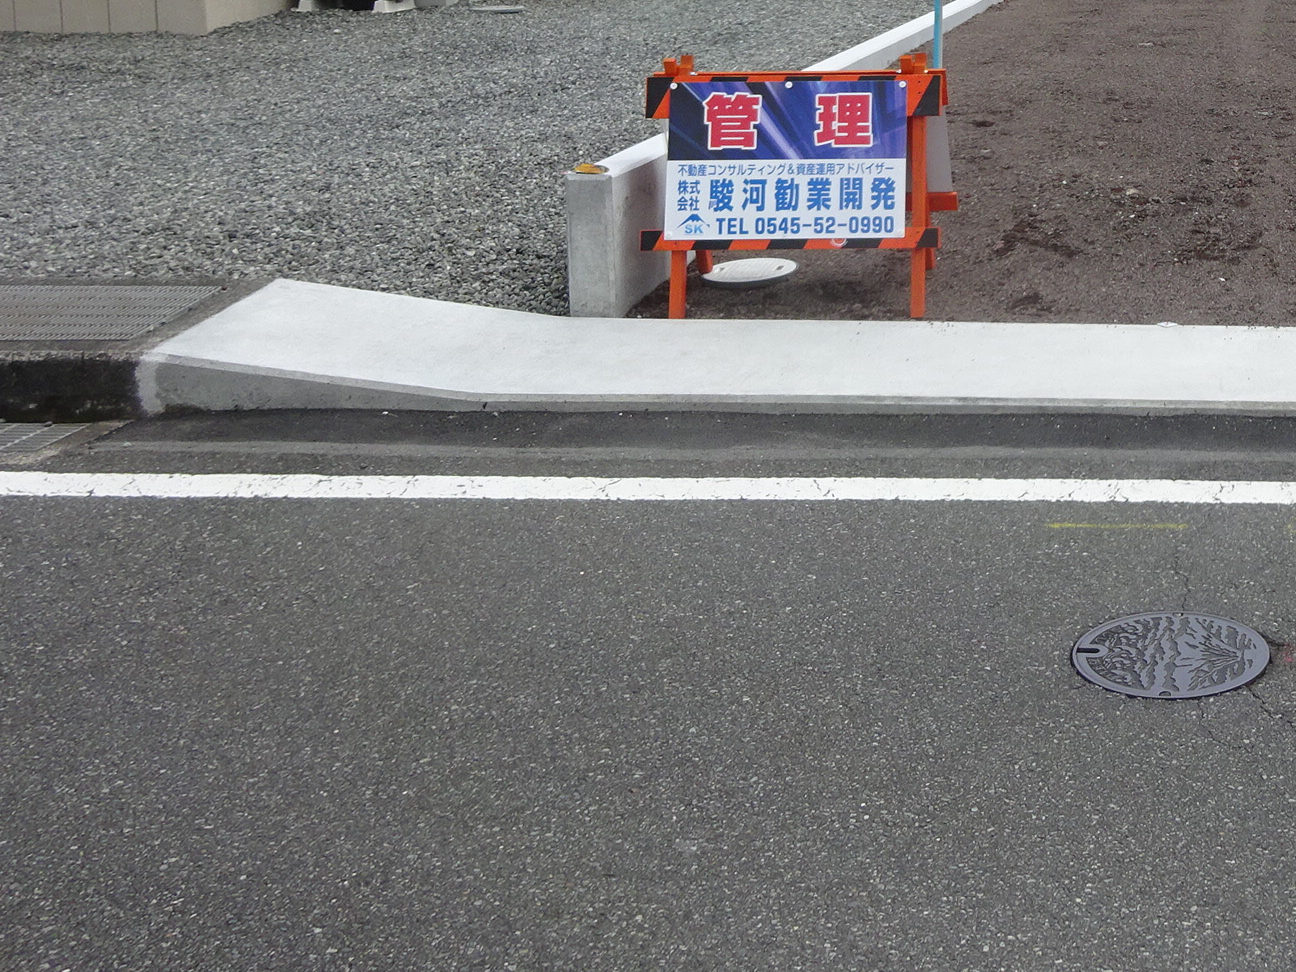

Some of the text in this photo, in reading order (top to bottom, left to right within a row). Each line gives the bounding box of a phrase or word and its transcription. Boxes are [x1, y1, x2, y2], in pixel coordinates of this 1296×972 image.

[703, 92, 873, 150] 管理
[677, 179, 700, 195] 株式
[708, 177, 896, 212] 駿河勧業開発
[677, 196, 700, 212] 会社
[684, 223, 704, 234] SK
[716, 216, 894, 235] TEL 0545-52-0990
